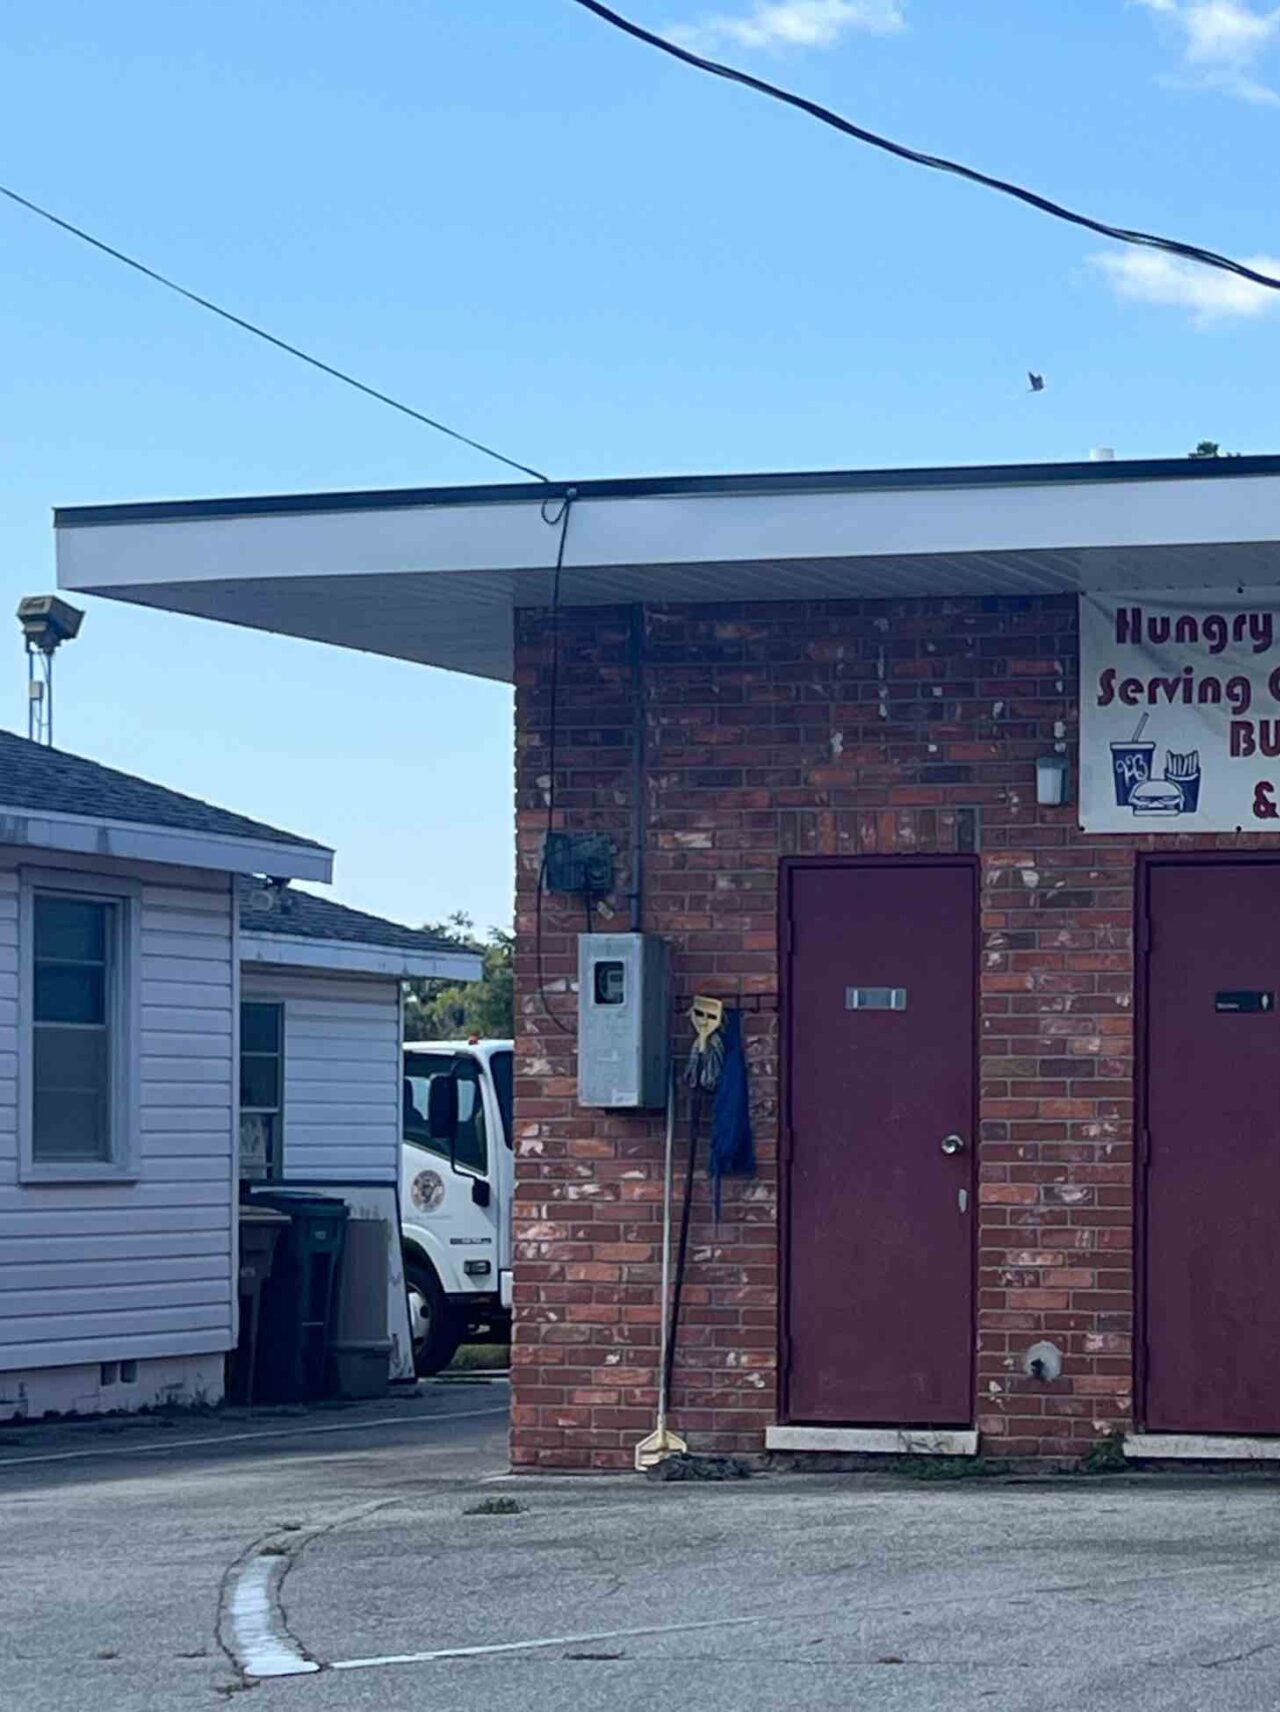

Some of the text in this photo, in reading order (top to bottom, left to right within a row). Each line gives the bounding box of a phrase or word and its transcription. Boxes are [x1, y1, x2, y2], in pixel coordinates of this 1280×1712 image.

[1114, 607, 1272, 654] Hungry
[1097, 666, 1251, 715] Serving
[1252, 780, 1280, 820] &
